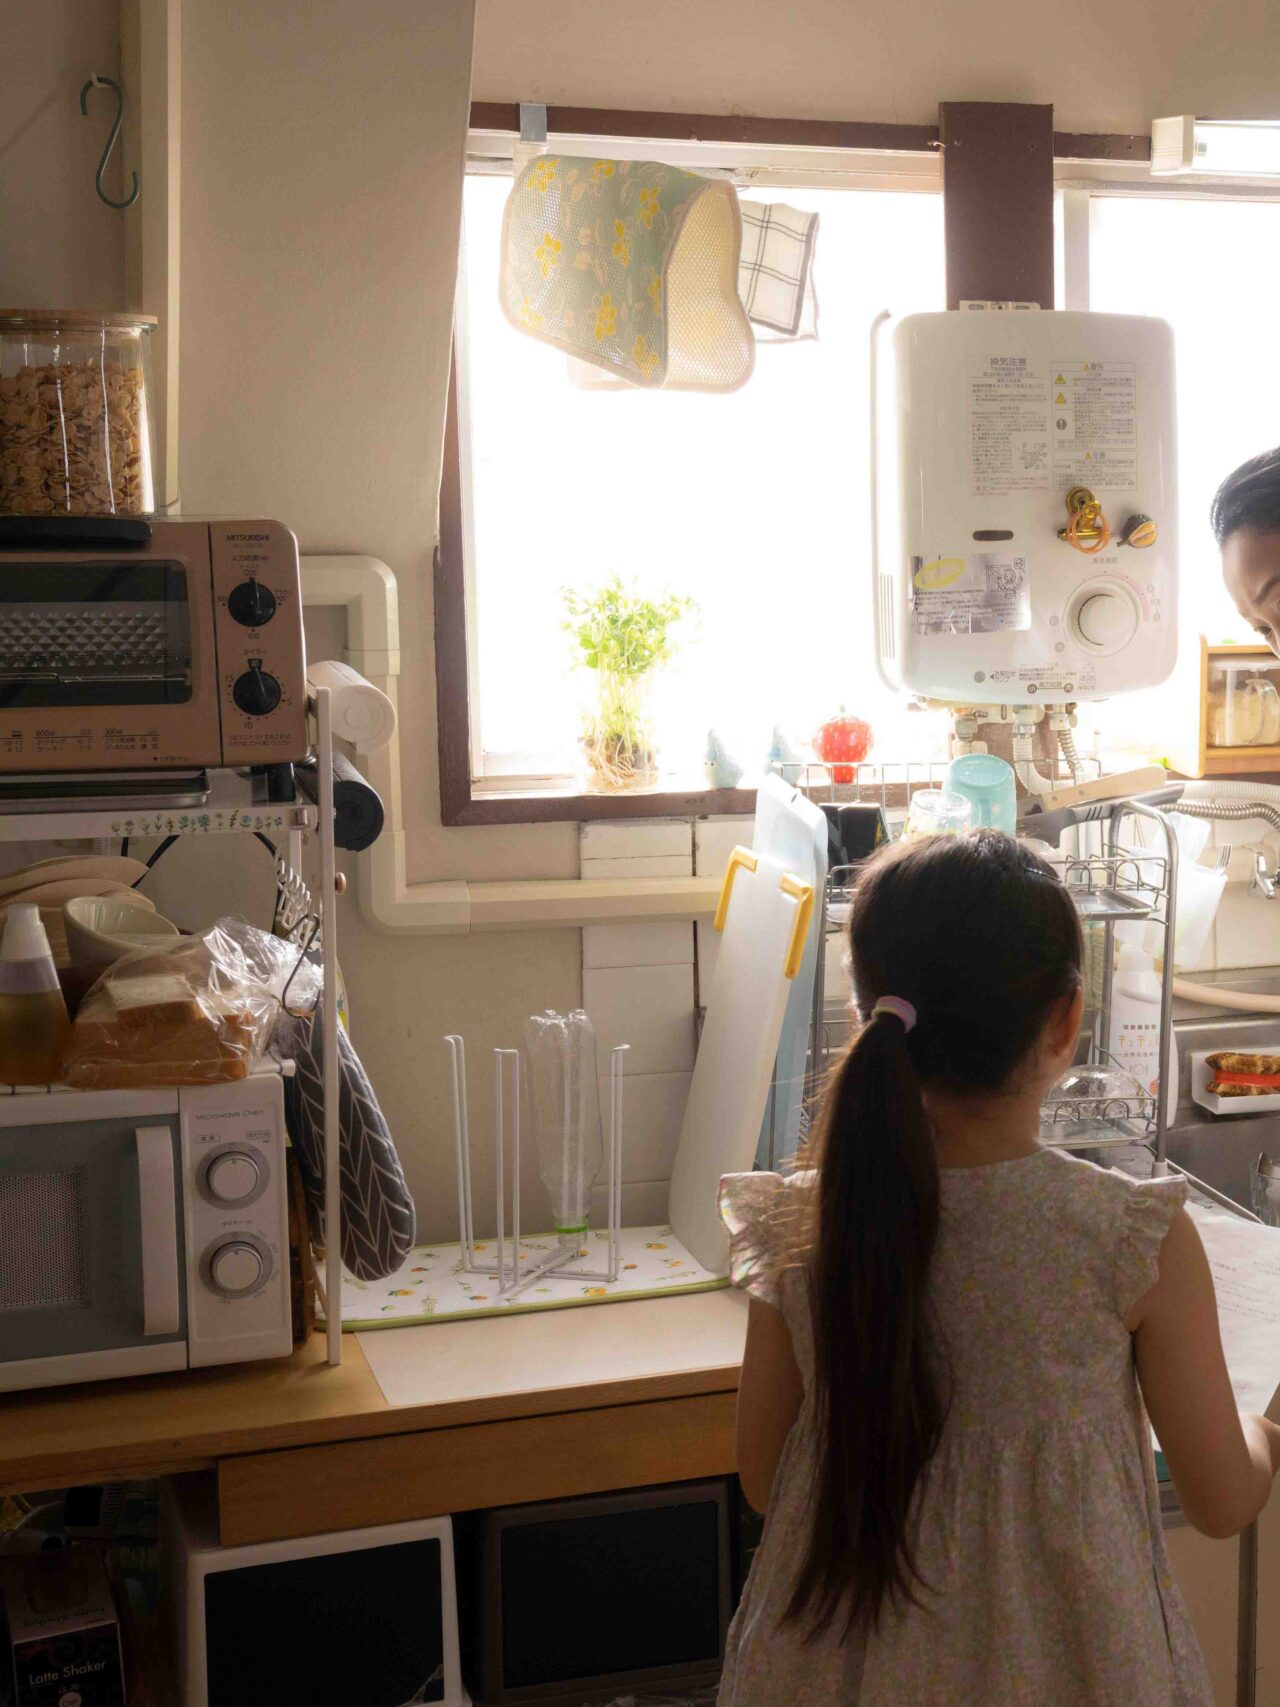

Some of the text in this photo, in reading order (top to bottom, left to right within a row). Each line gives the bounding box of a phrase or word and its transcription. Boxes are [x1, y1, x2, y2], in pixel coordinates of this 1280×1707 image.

[226, 534, 270, 542] MITSUBISHI
[196, 1109, 265, 1121] Microwave Oven
[30, 1661, 107, 1686] Latte Shaker
